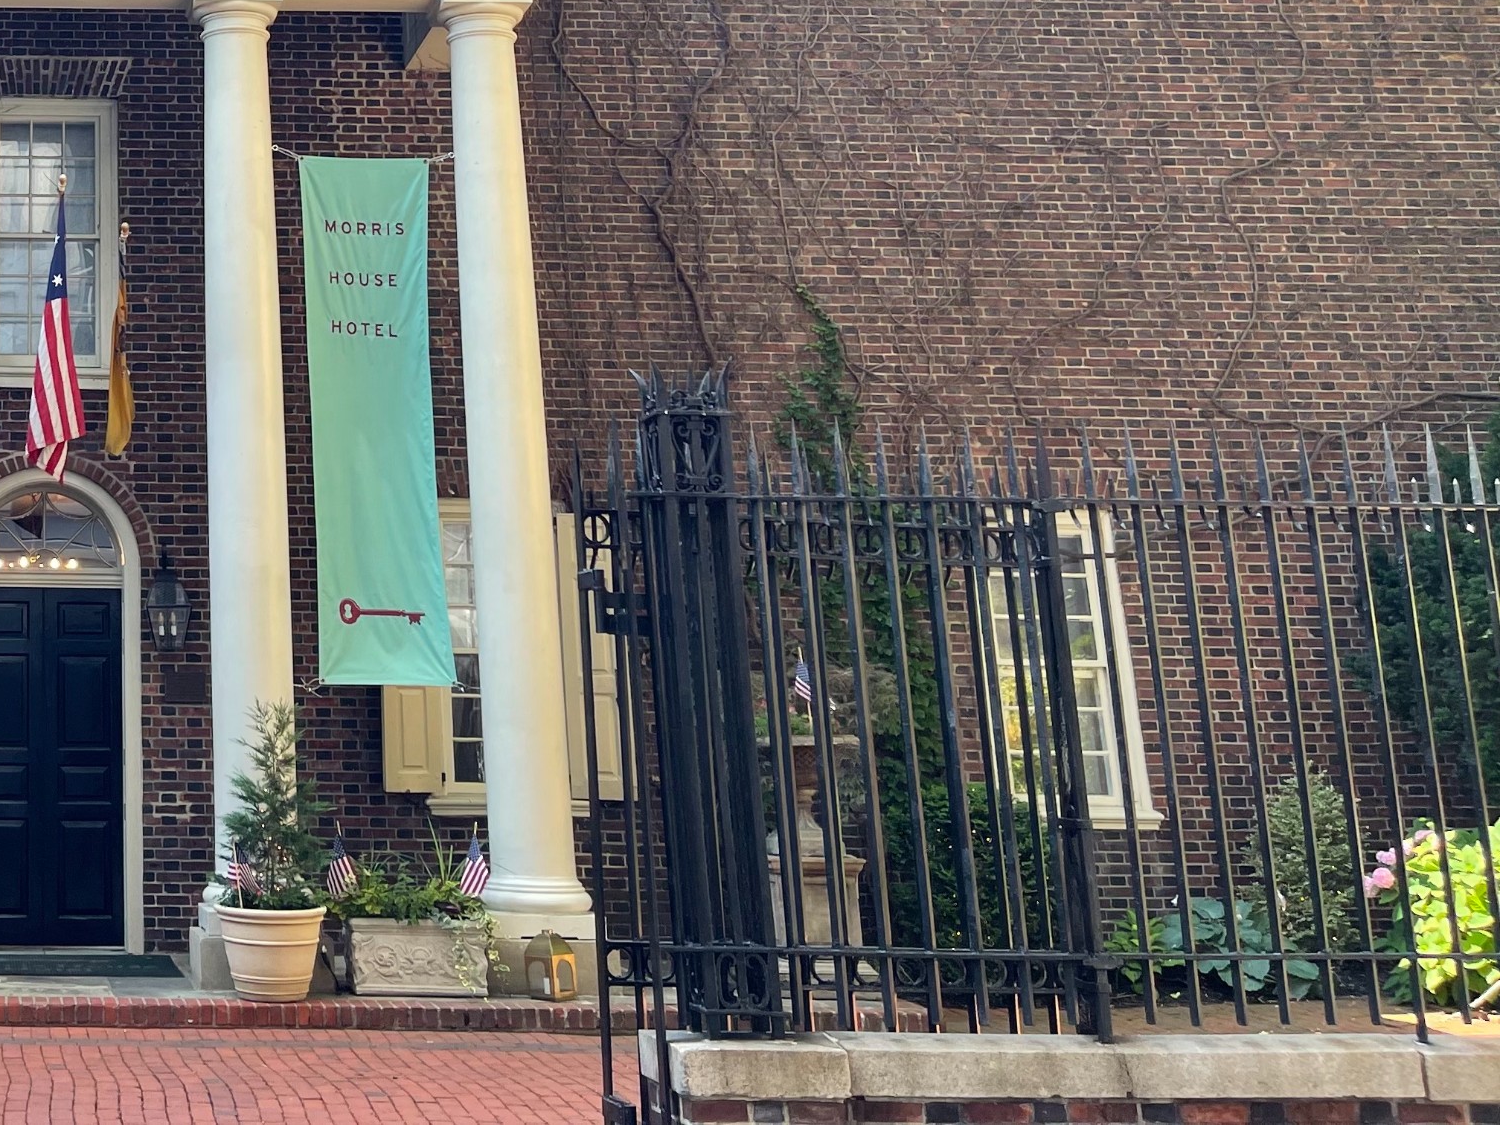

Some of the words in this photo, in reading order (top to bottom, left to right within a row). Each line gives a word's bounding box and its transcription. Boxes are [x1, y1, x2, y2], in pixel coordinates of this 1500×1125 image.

[324, 219, 405, 236] MORRIS
[329, 271, 398, 287] HOUSE
[331, 319, 398, 338] HOTEL
